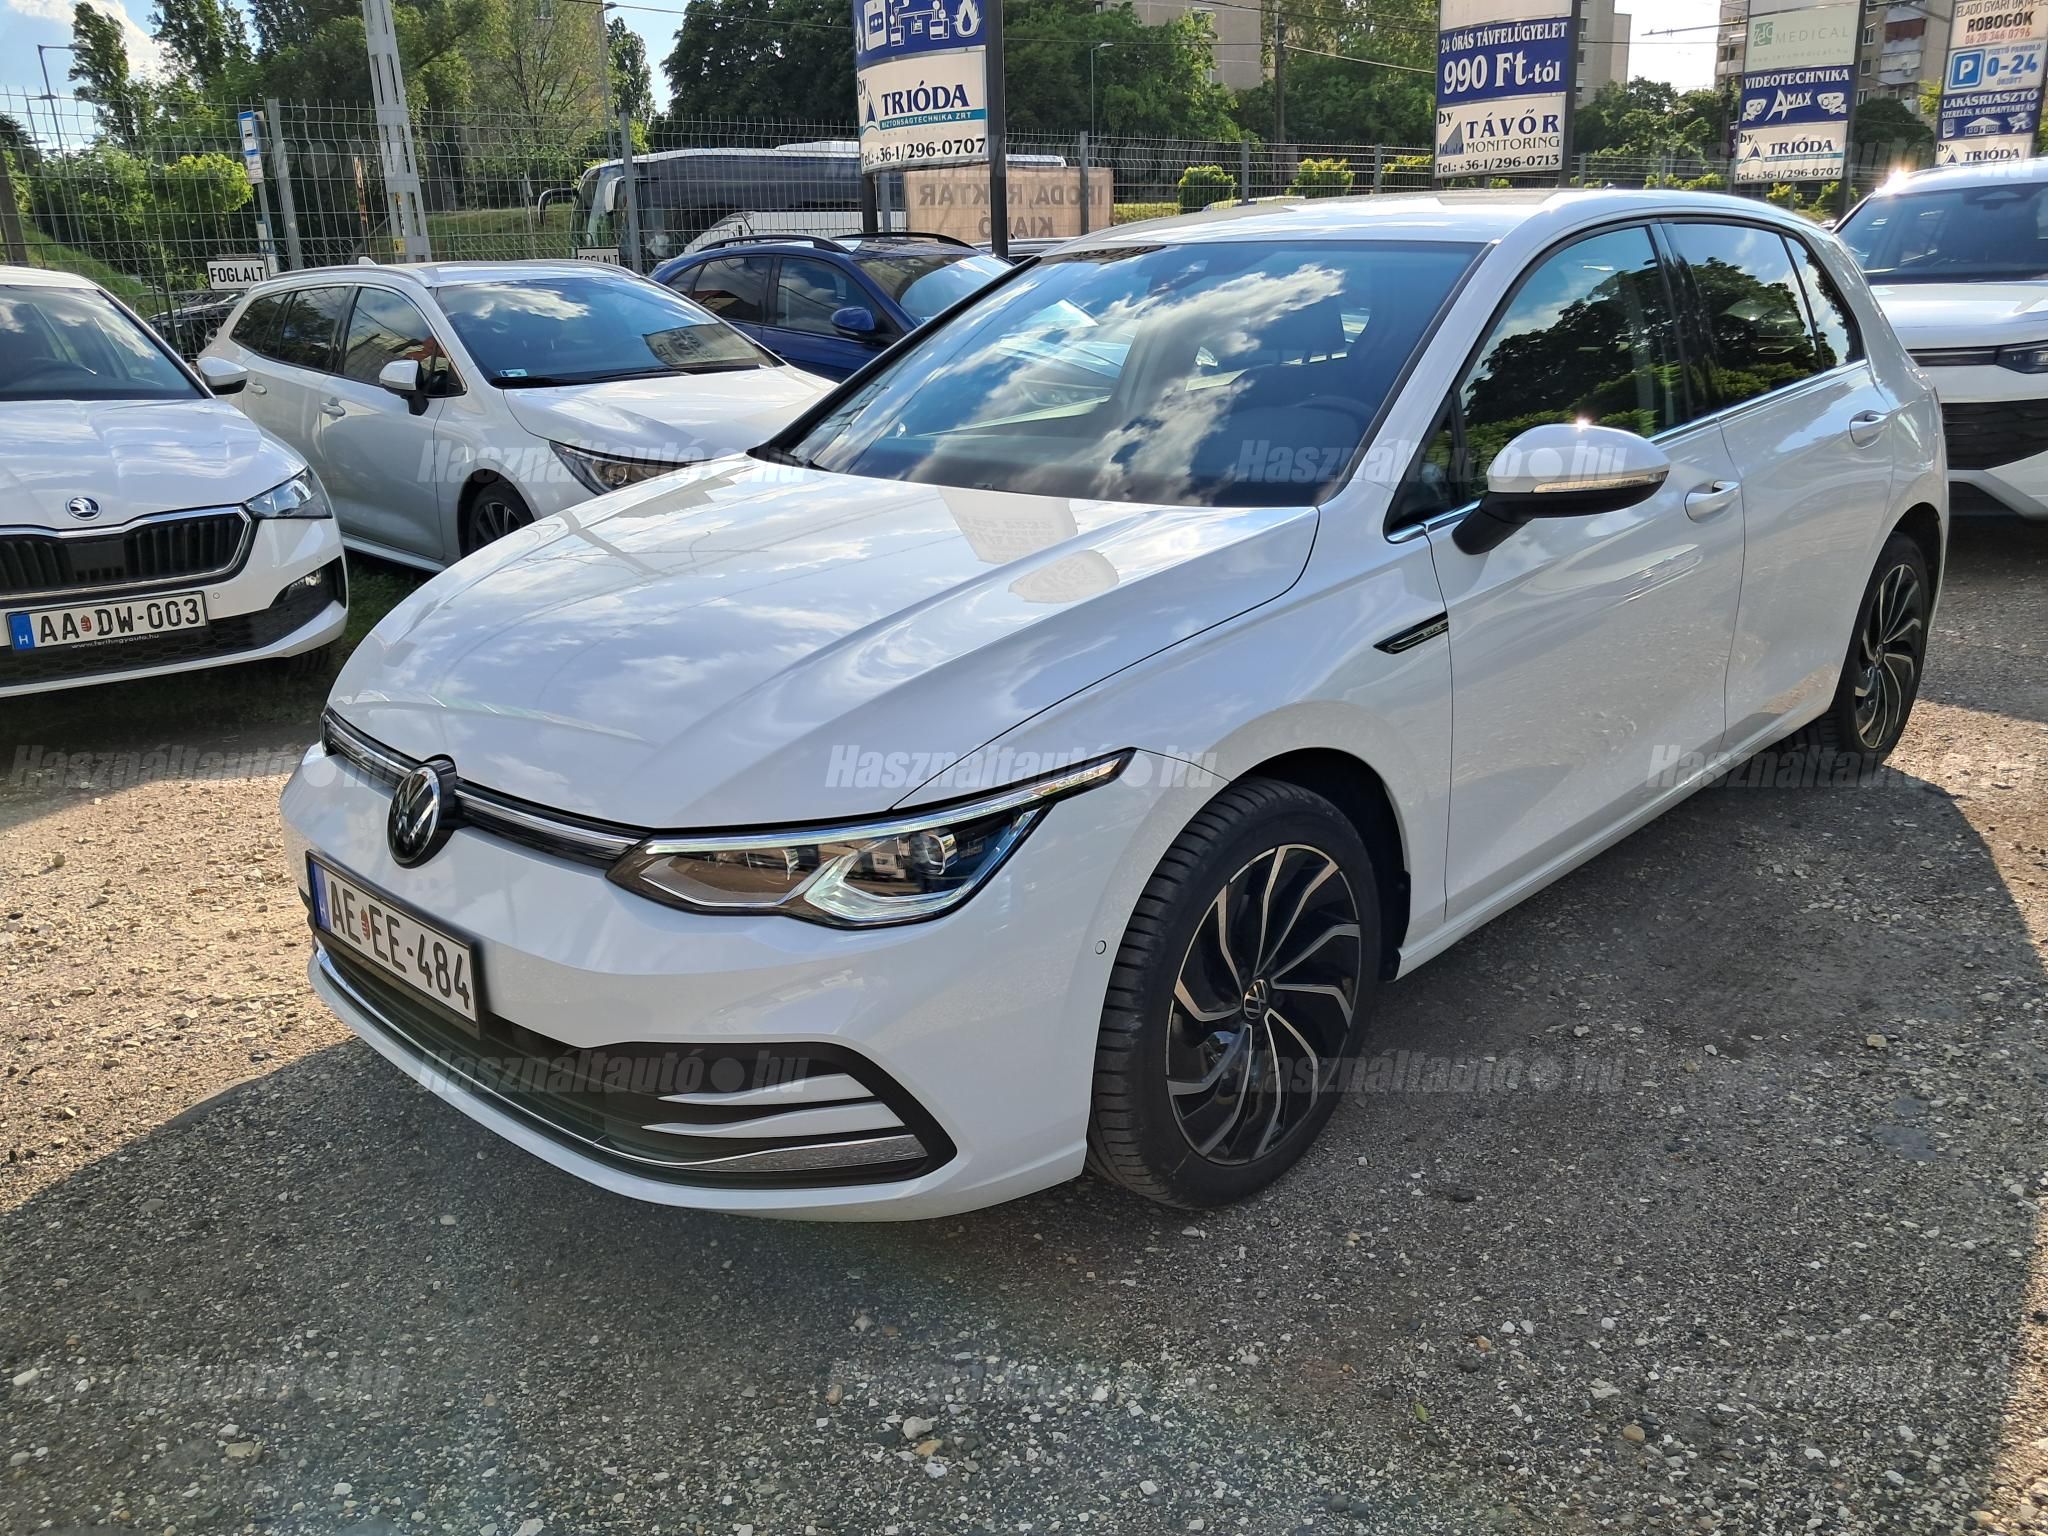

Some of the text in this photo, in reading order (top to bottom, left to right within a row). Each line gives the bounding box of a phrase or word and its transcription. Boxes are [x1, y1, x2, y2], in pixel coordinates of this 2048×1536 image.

[1967, 8, 2034, 33] ROBOGÓK
[1441, 22, 1567, 53] 24 ÓRÁS TÁVFELÜGYELET
[1776, 26, 1848, 43] MEDICAL
[1443, 50, 1561, 95] 990 Ft-tól
[1987, 53, 2038, 77] 0-24
[1745, 69, 1849, 89] VIDEOTECHNIKA
[858, 77, 970, 116] by TRIÓDA
[1943, 88, 2038, 109] LAKÁSRIASZTÓ
[956, 111, 971, 120] ZRT
[1439, 109, 1560, 139] by TÁVŐR
[876, 138, 985, 163] +36-1/296-0707
[1466, 136, 1560, 154] MONITORING
[1740, 132, 1833, 155] by TRIÓDA
[1965, 147, 2020, 161] TRIÓDA
[1437, 154, 1560, 174] Tel.: +36-1/296-0713
[1757, 167, 1841, 180] +36-1/296-0707
[210, 267, 264, 283] FOGLALT
[18, 598, 200, 645] H AA DW-003
[330, 880, 361, 945] AE
[368, 903, 470, 1010] EE-484
